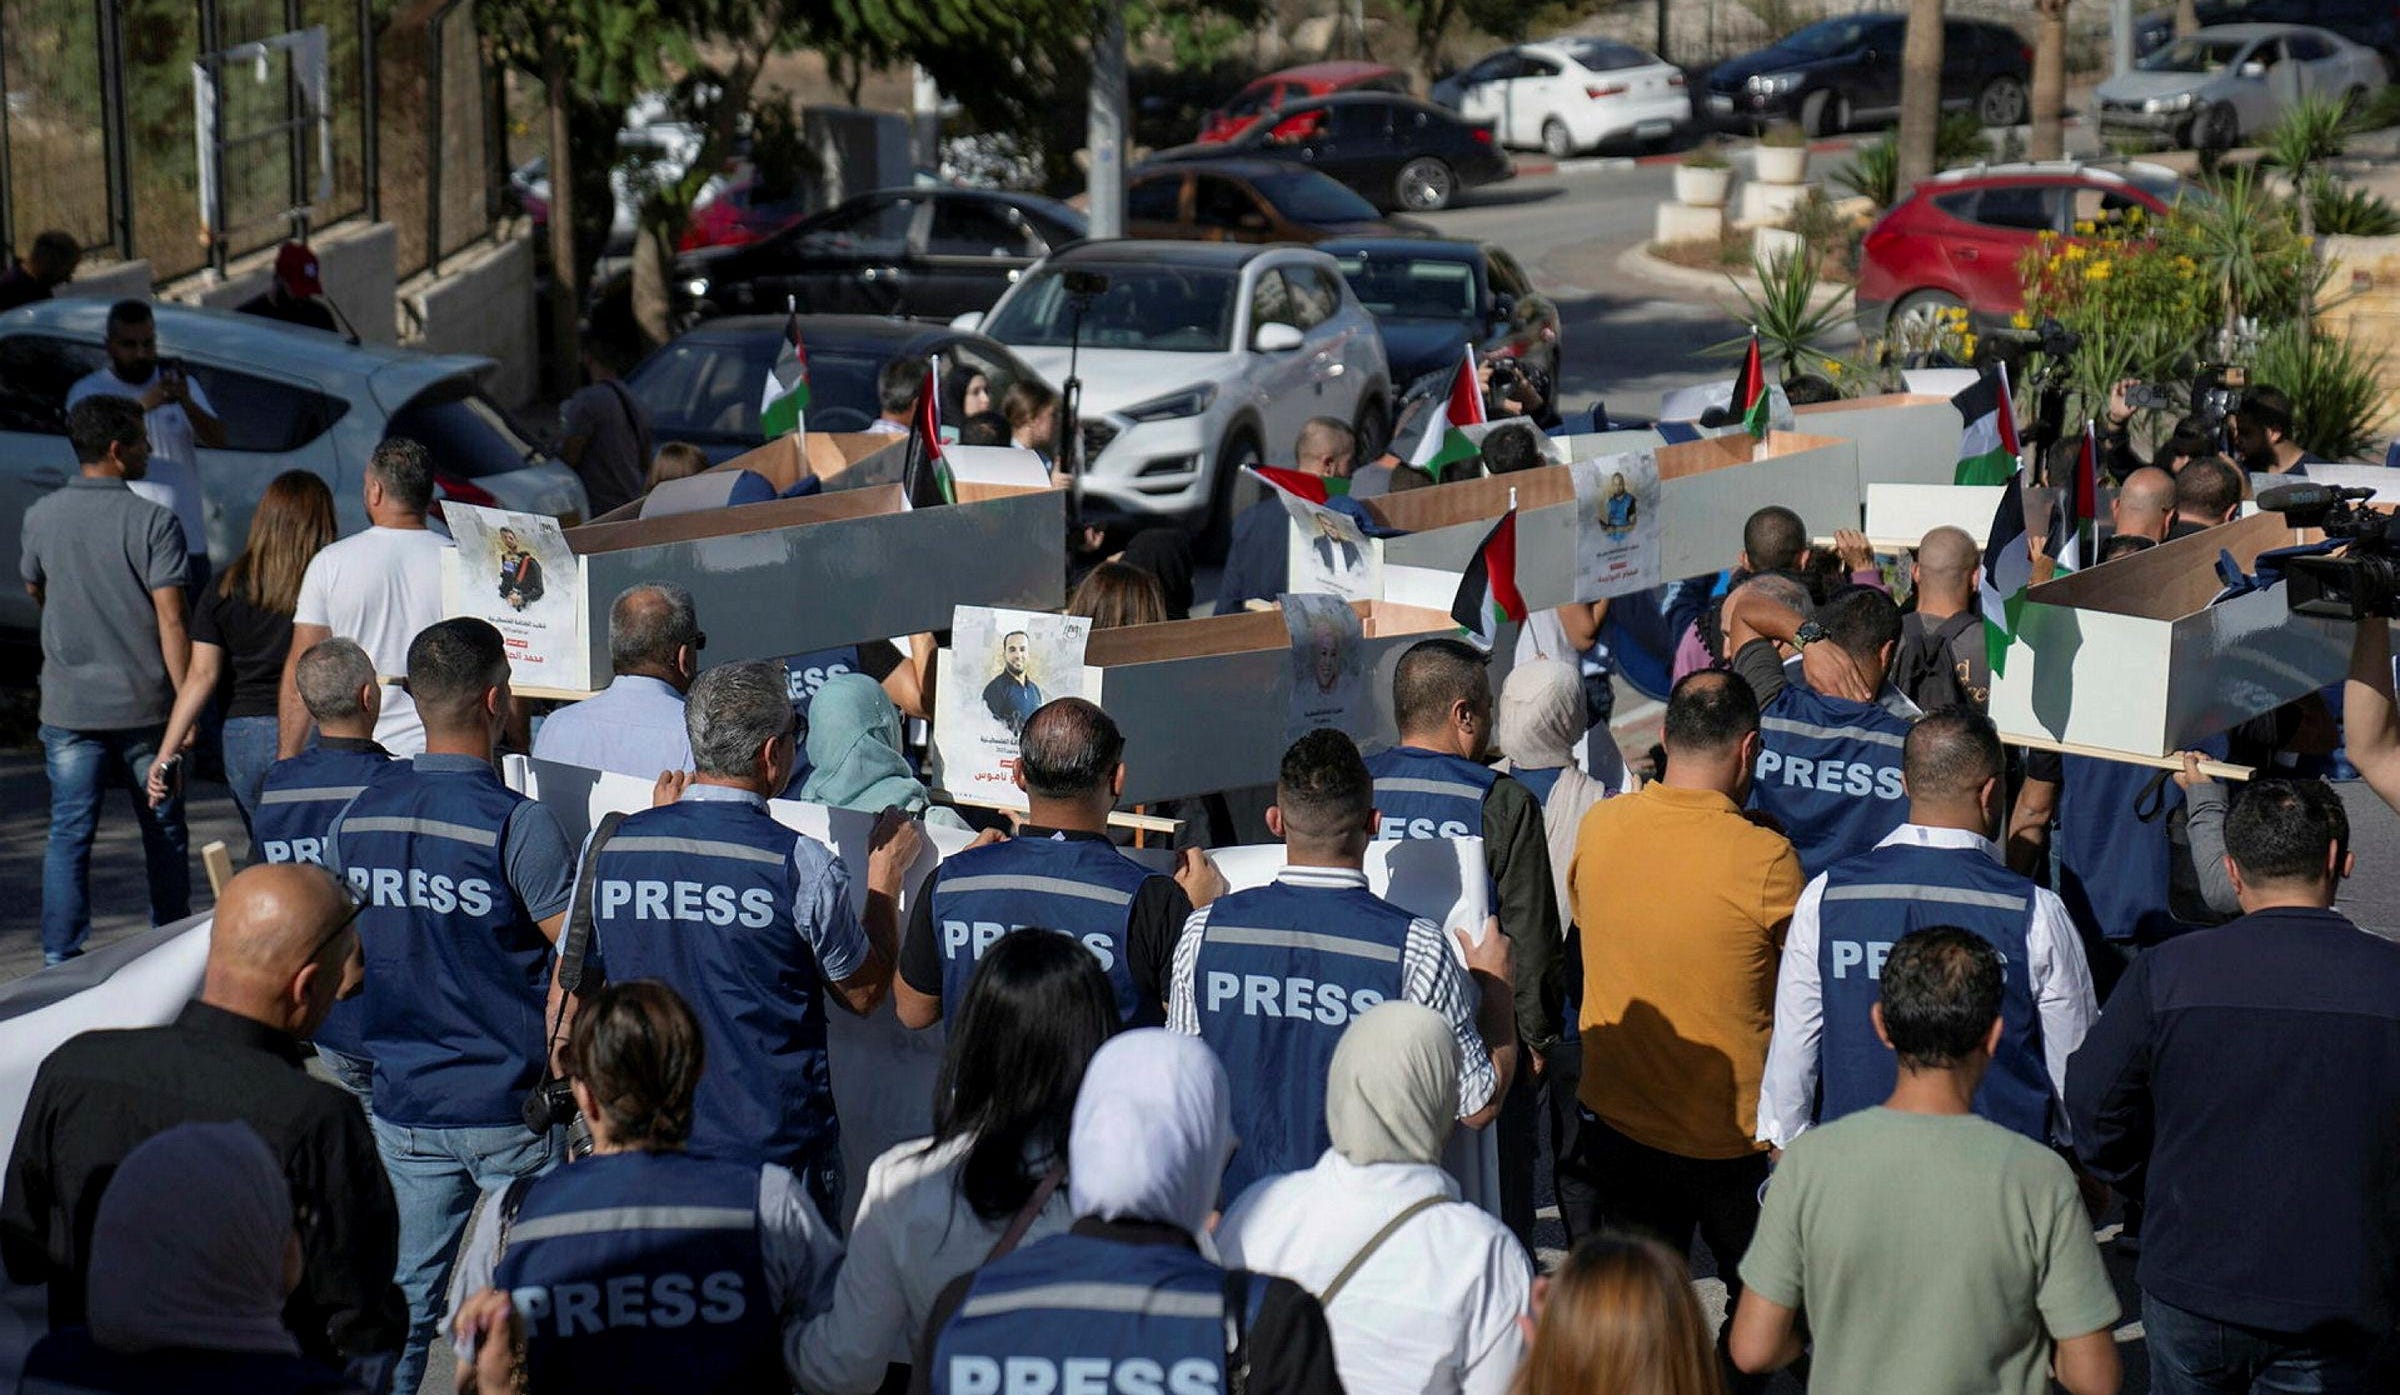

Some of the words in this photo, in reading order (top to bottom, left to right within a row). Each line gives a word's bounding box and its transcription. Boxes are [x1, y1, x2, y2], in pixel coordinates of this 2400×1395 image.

[786, 663, 850, 700] ESS
[1755, 749, 1903, 800] PRESS
[1378, 816, 1469, 840] ESS
[348, 866, 493, 917] PRESS
[601, 879, 775, 929] PRESS
[942, 920, 1114, 973] PRS
[511, 1270, 747, 1338] PRESS
[950, 1355, 1221, 1395] PRESS
